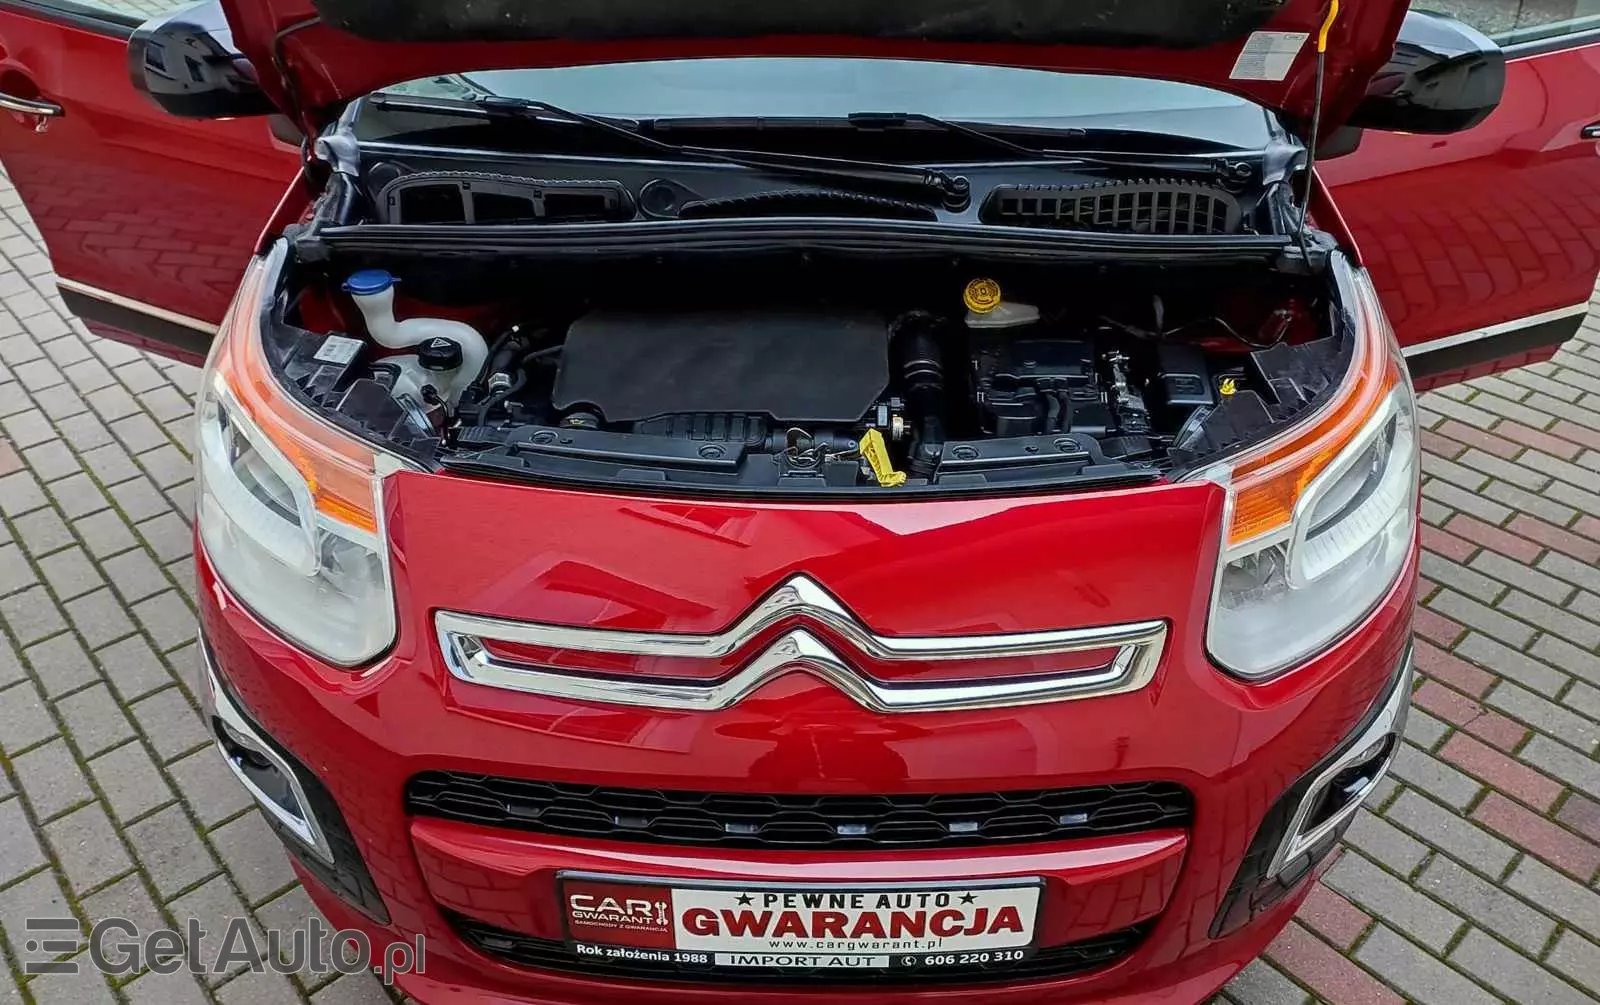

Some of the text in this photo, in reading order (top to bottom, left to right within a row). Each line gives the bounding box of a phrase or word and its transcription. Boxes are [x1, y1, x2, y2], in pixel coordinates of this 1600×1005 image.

[763, 892, 950, 909] PEWNE AUTO
[572, 910, 653, 925] GWARANT
[682, 906, 1024, 938] GWARANCJA
[769, 938, 942, 950] www.cargwarant.pl
[577, 944, 708, 963] Rok założenia 1988
[730, 955, 876, 967] IMPORT AUT
[925, 950, 1024, 966] 606 220 310
